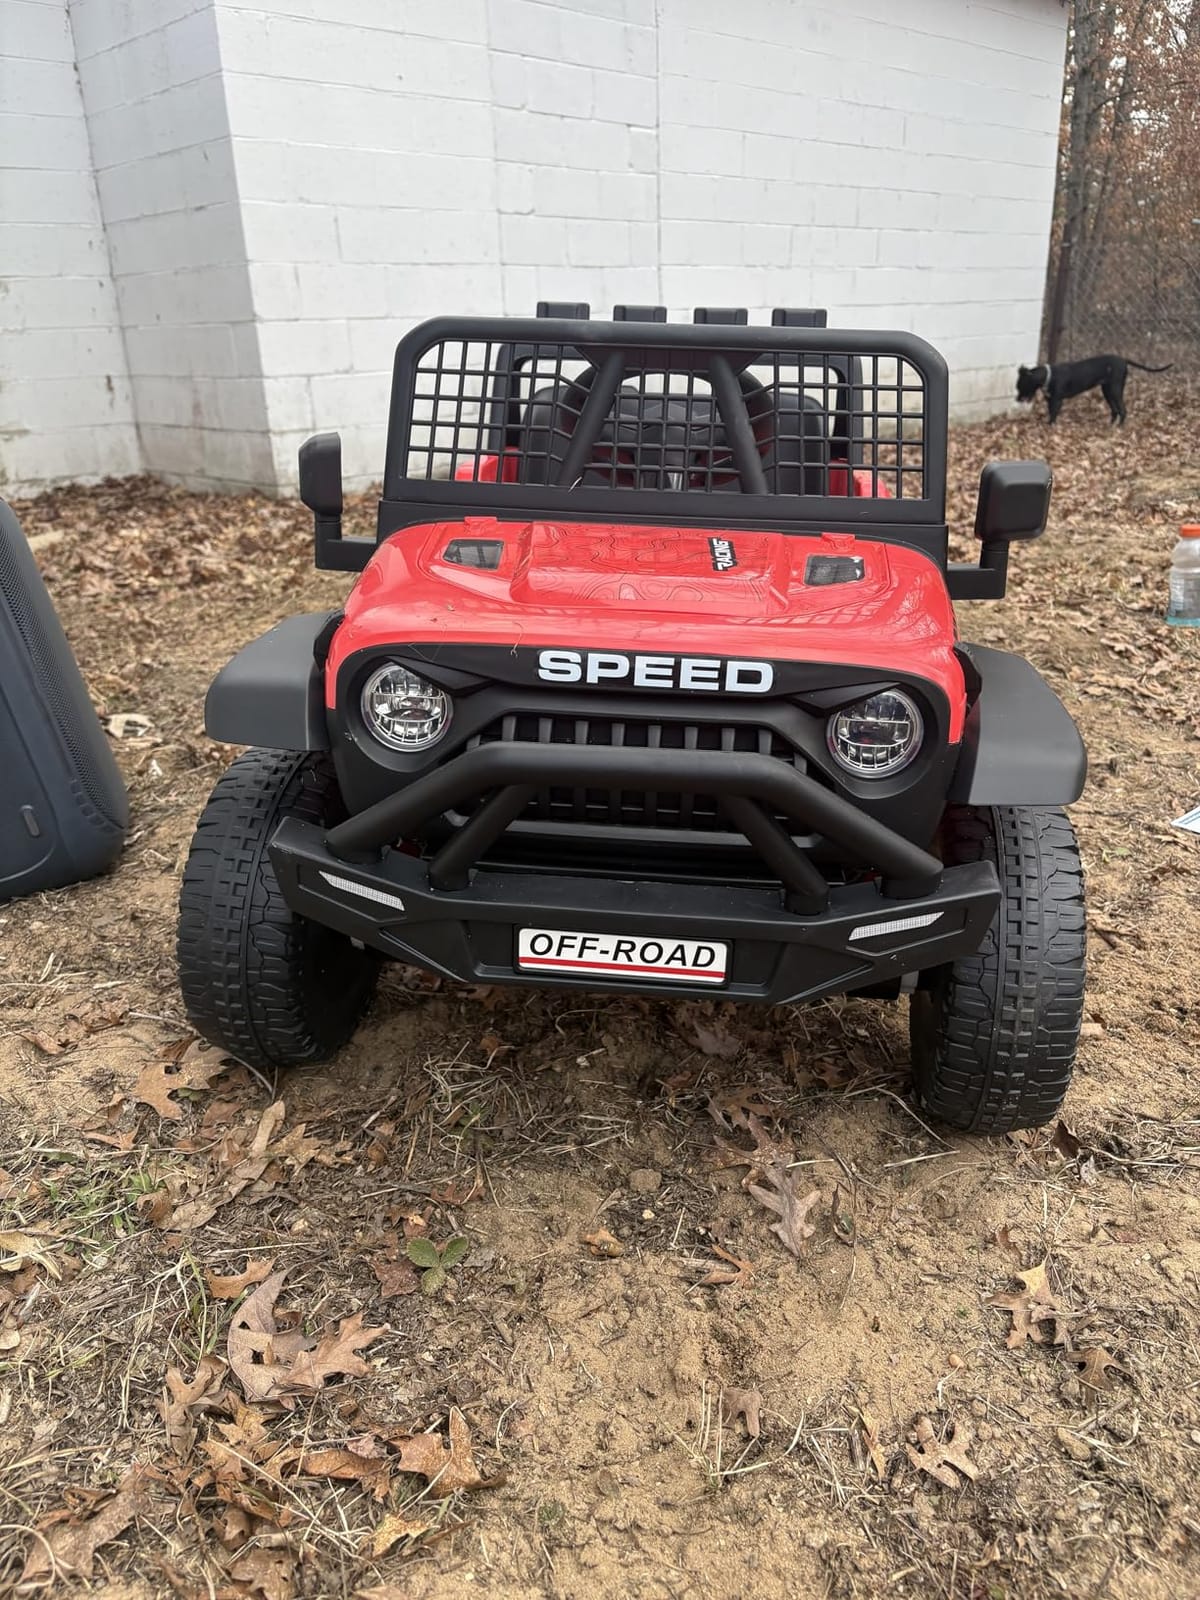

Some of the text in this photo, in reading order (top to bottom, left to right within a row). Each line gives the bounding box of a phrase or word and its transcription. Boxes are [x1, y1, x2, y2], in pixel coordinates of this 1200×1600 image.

[712, 537, 734, 571] RACING
[537, 649, 774, 694] SPEED
[529, 933, 716, 968] OFF-ROAD
